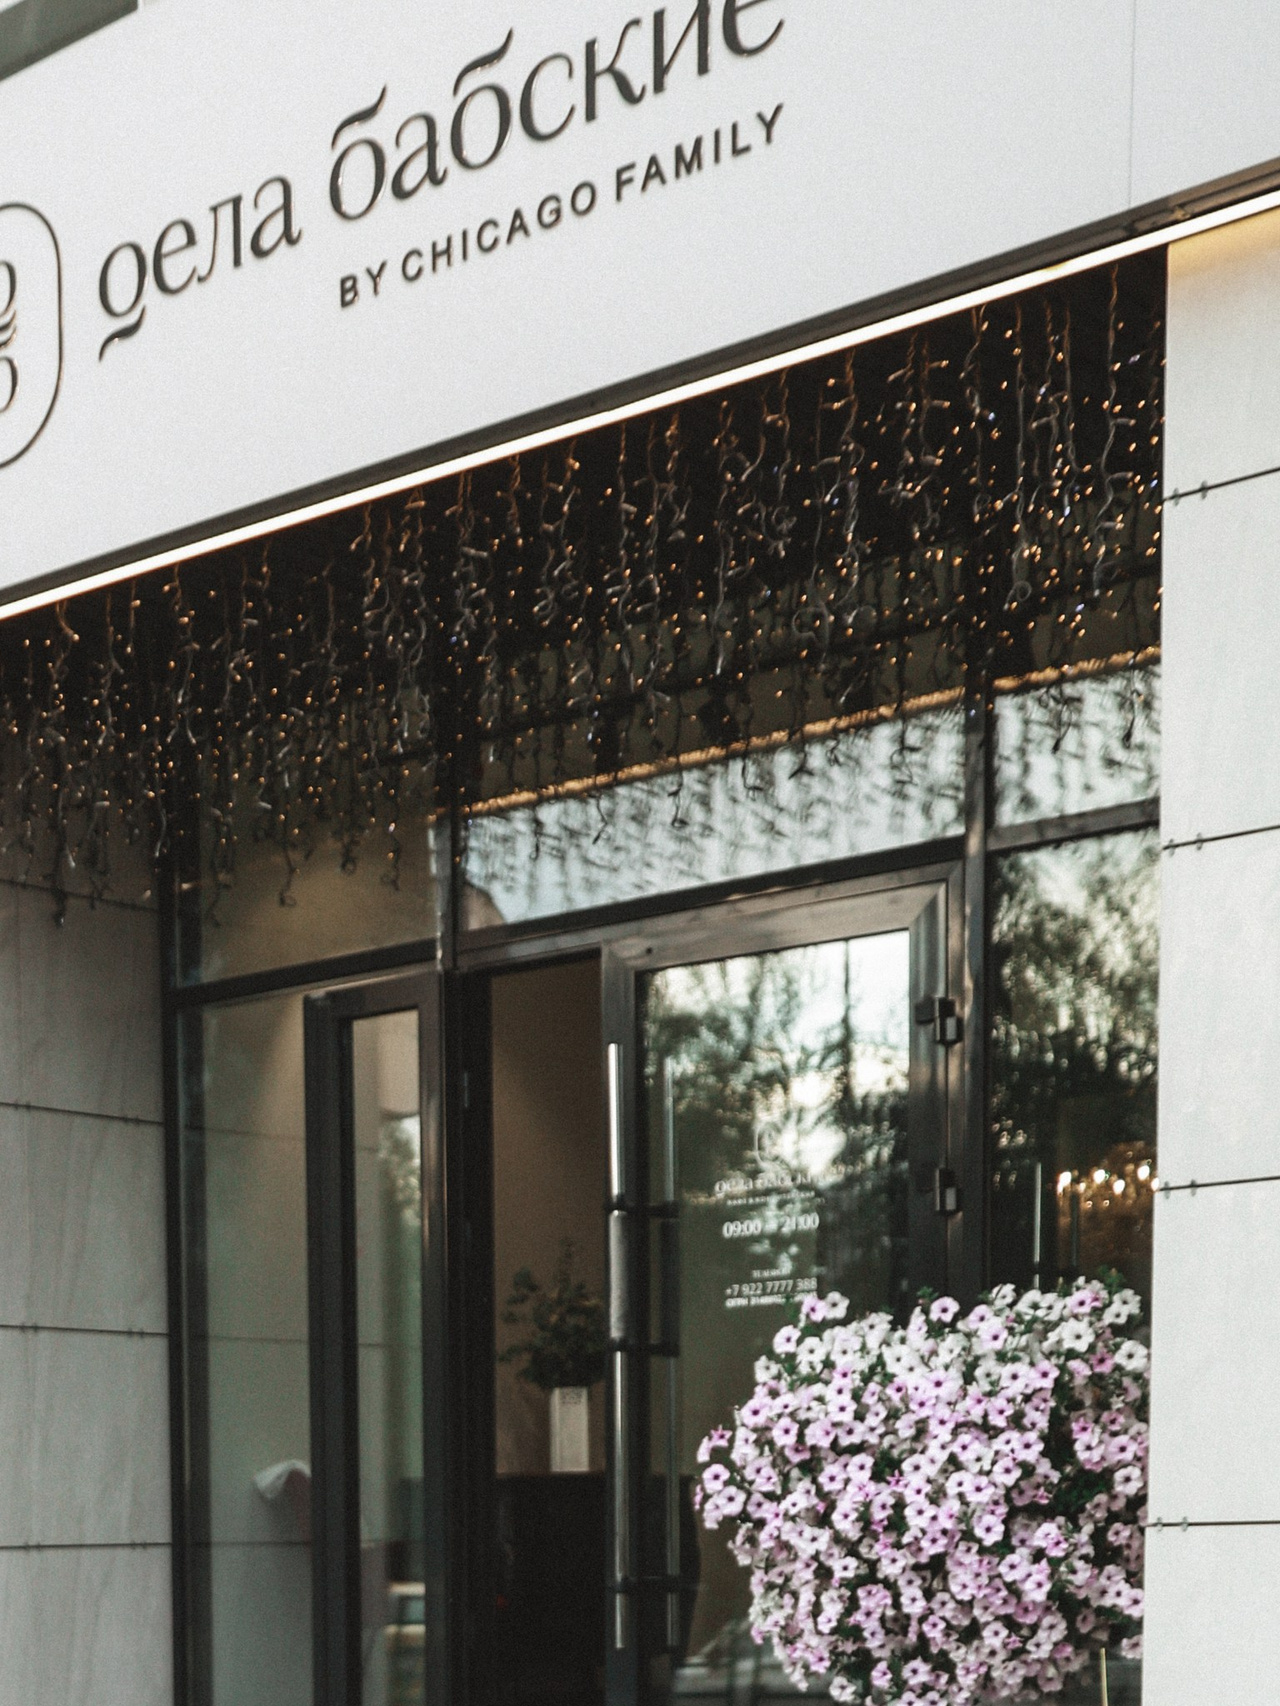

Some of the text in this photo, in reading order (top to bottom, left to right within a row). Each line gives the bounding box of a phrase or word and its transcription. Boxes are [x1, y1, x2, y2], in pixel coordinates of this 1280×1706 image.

[98, 0, 785, 362] дела бабские
[339, 103, 785, 309] BY CHICAGO FAMILY
[722, 1219, 762, 1238] 09:00
[725, 1283, 740, 1297] +7
[741, 1281, 763, 1296] 922
[766, 1279, 794, 1295] 7777
